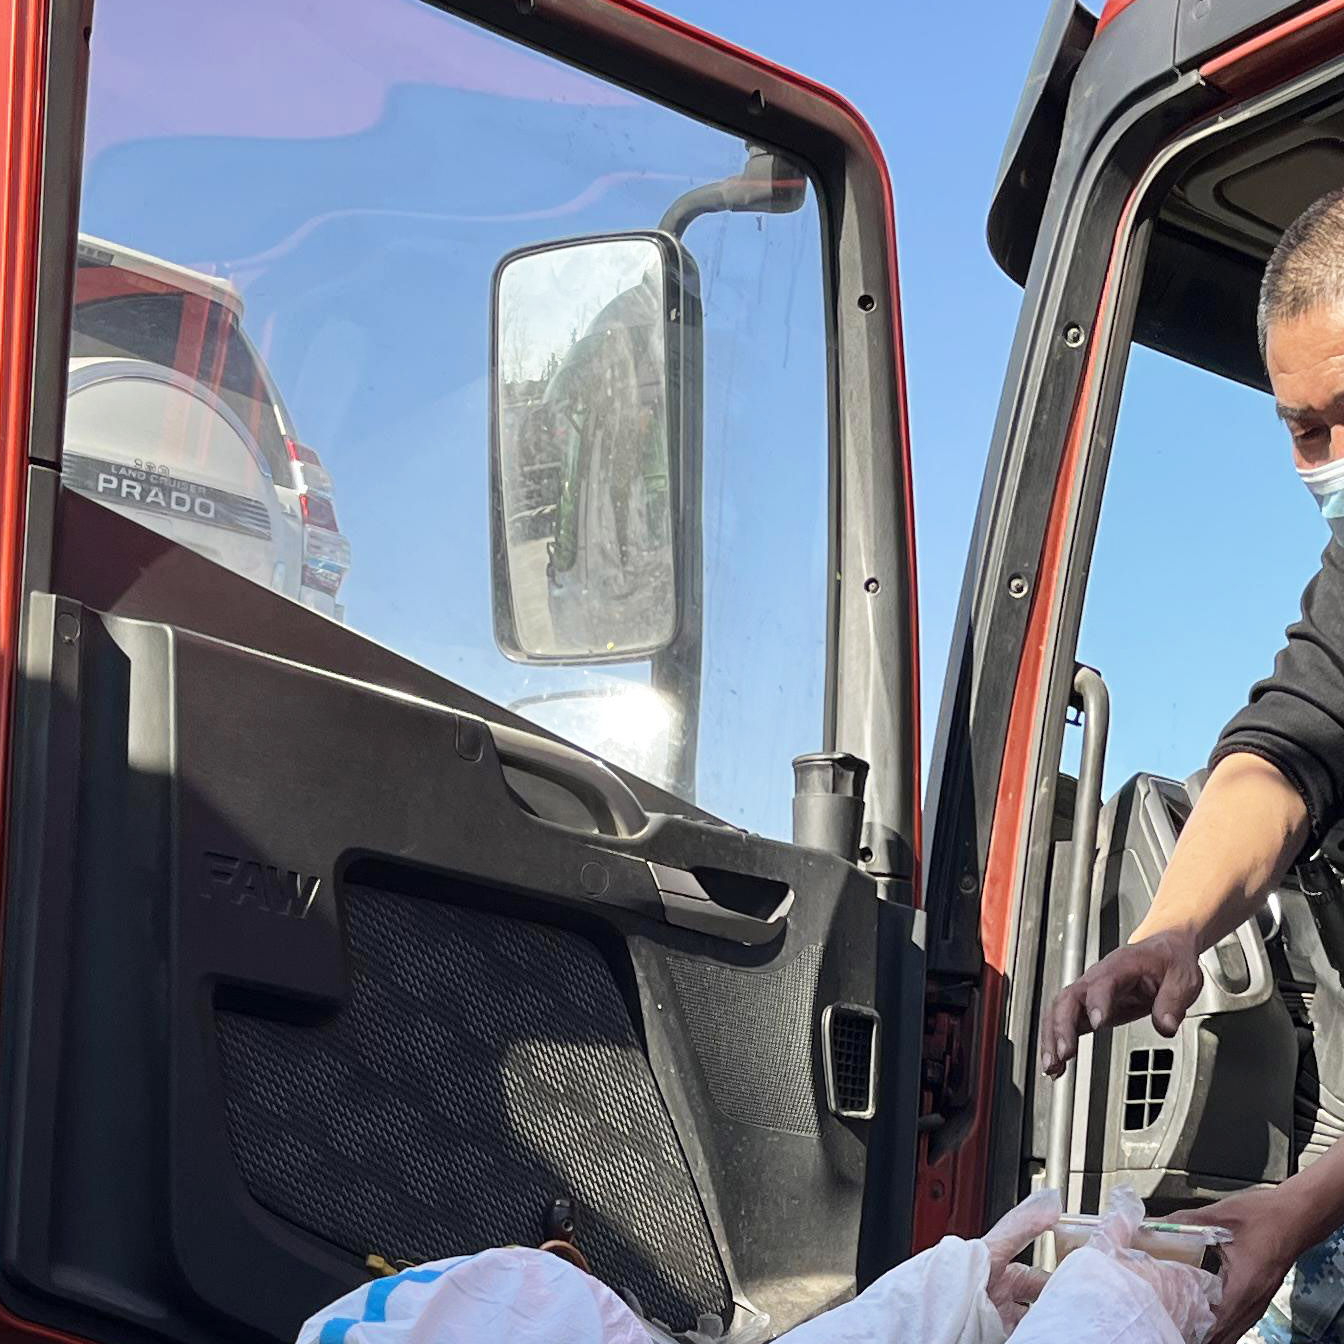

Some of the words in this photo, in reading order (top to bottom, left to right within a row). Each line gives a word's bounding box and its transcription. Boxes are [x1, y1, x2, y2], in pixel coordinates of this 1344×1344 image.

[110, 464, 146, 481] LAND
[96, 473, 216, 519] PRADO
[201, 850, 321, 919] FAW
